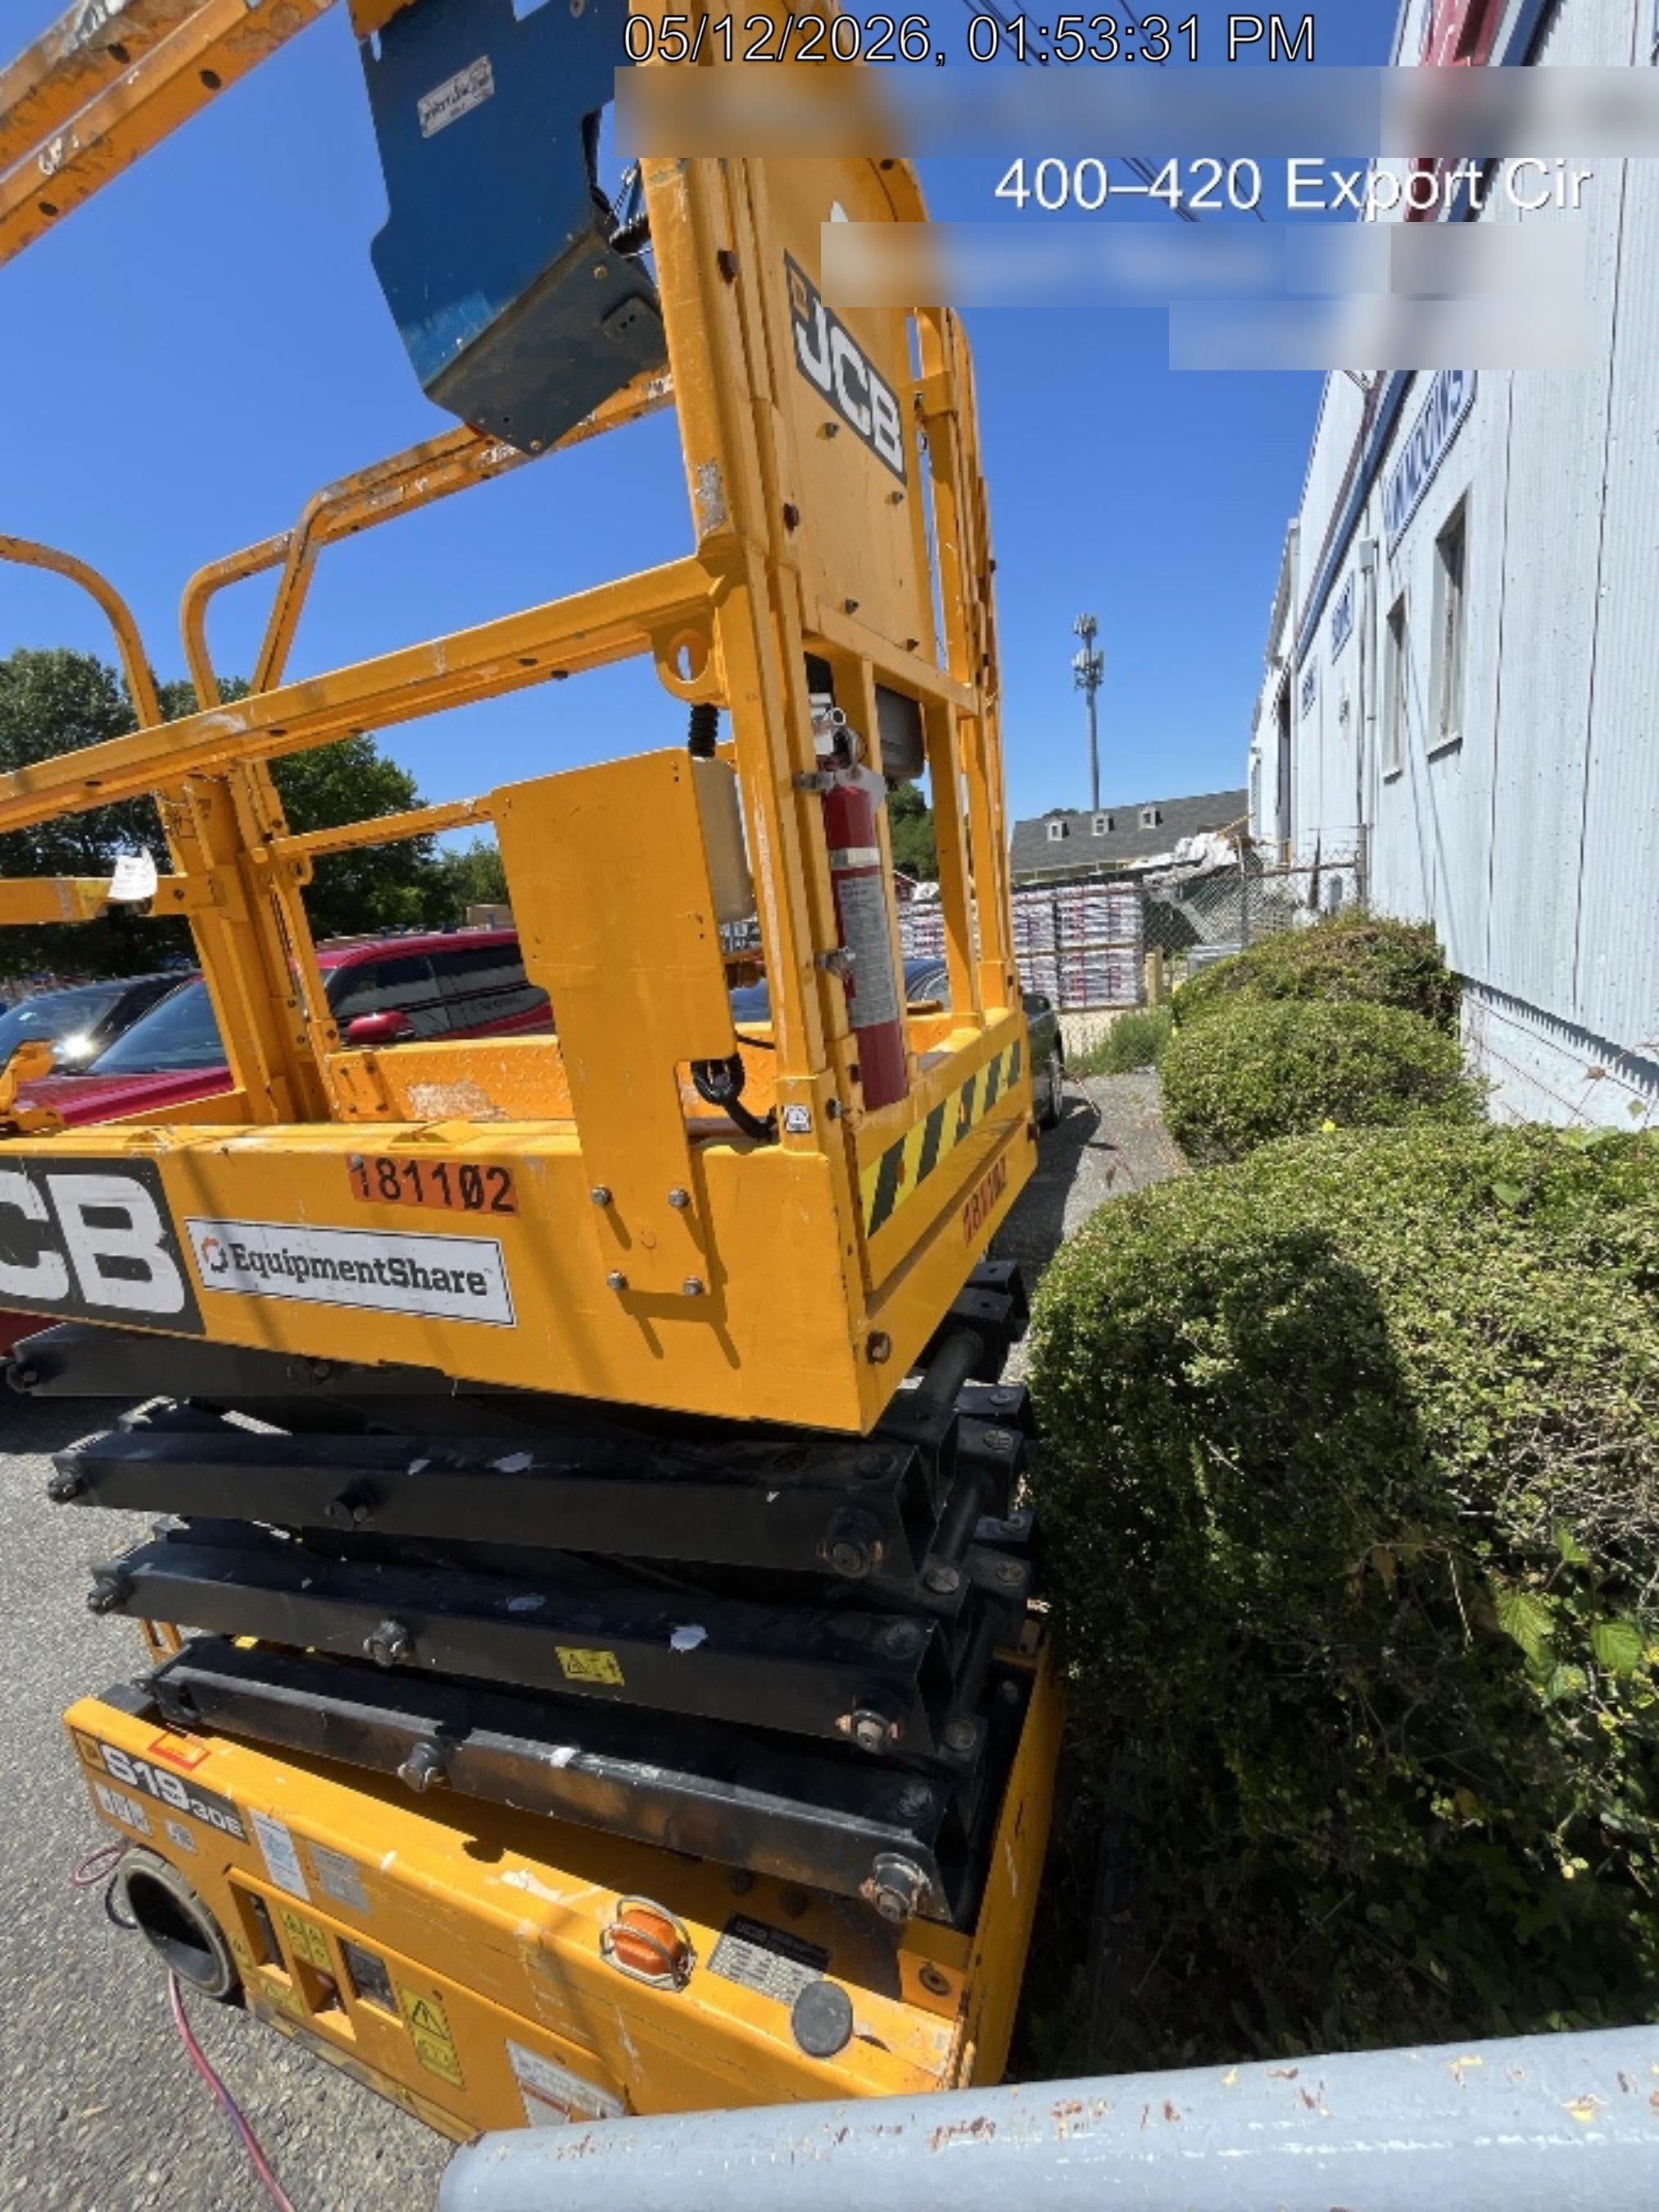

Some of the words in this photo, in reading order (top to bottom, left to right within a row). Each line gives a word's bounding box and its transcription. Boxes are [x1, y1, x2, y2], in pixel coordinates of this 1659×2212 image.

[796, 297, 903, 473] JCB
[352, 1157, 514, 1212] 181102
[231, 1243, 487, 1296] EquipmentShare
